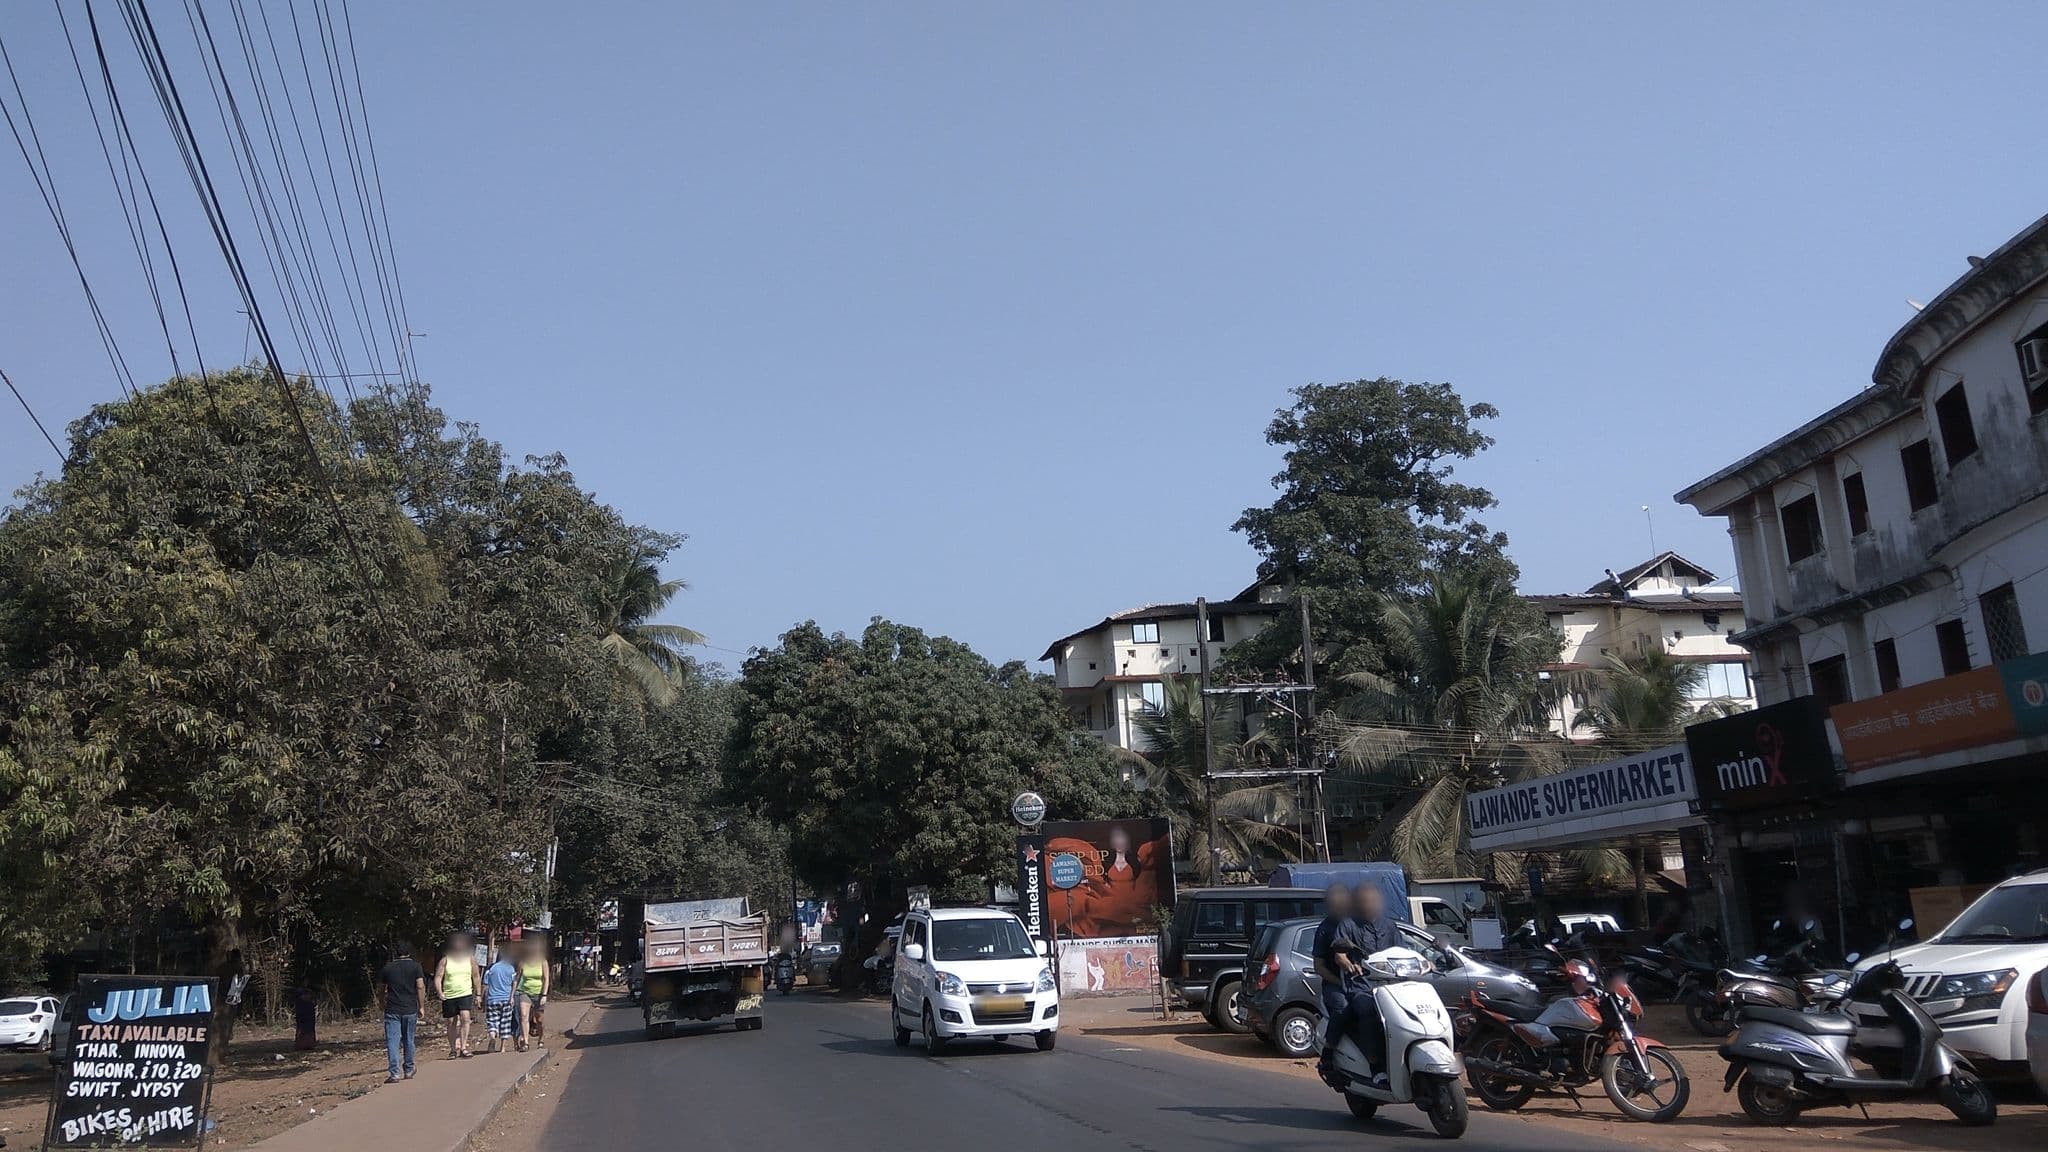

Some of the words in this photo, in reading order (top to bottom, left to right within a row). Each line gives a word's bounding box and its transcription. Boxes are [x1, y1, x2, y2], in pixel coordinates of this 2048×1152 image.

[1470, 786, 1541, 829] LAWANDE
[1543, 752, 1686, 817] SUPERMARKET
[1090, 850, 1109, 862] UP
[1027, 866, 1041, 936] Heineken
[699, 944, 716, 953] OK
[731, 941, 758, 950] HORN
[88, 984, 212, 1023] JULIA
[78, 1024, 119, 1041] TAXI
[121, 1025, 206, 1043] AVAILABLE
[134, 1044, 186, 1059] INNOVA
[130, 1082, 185, 1098] JYPSY
[61, 1107, 132, 1142] BIKES
[147, 1105, 194, 1136] HIRE
